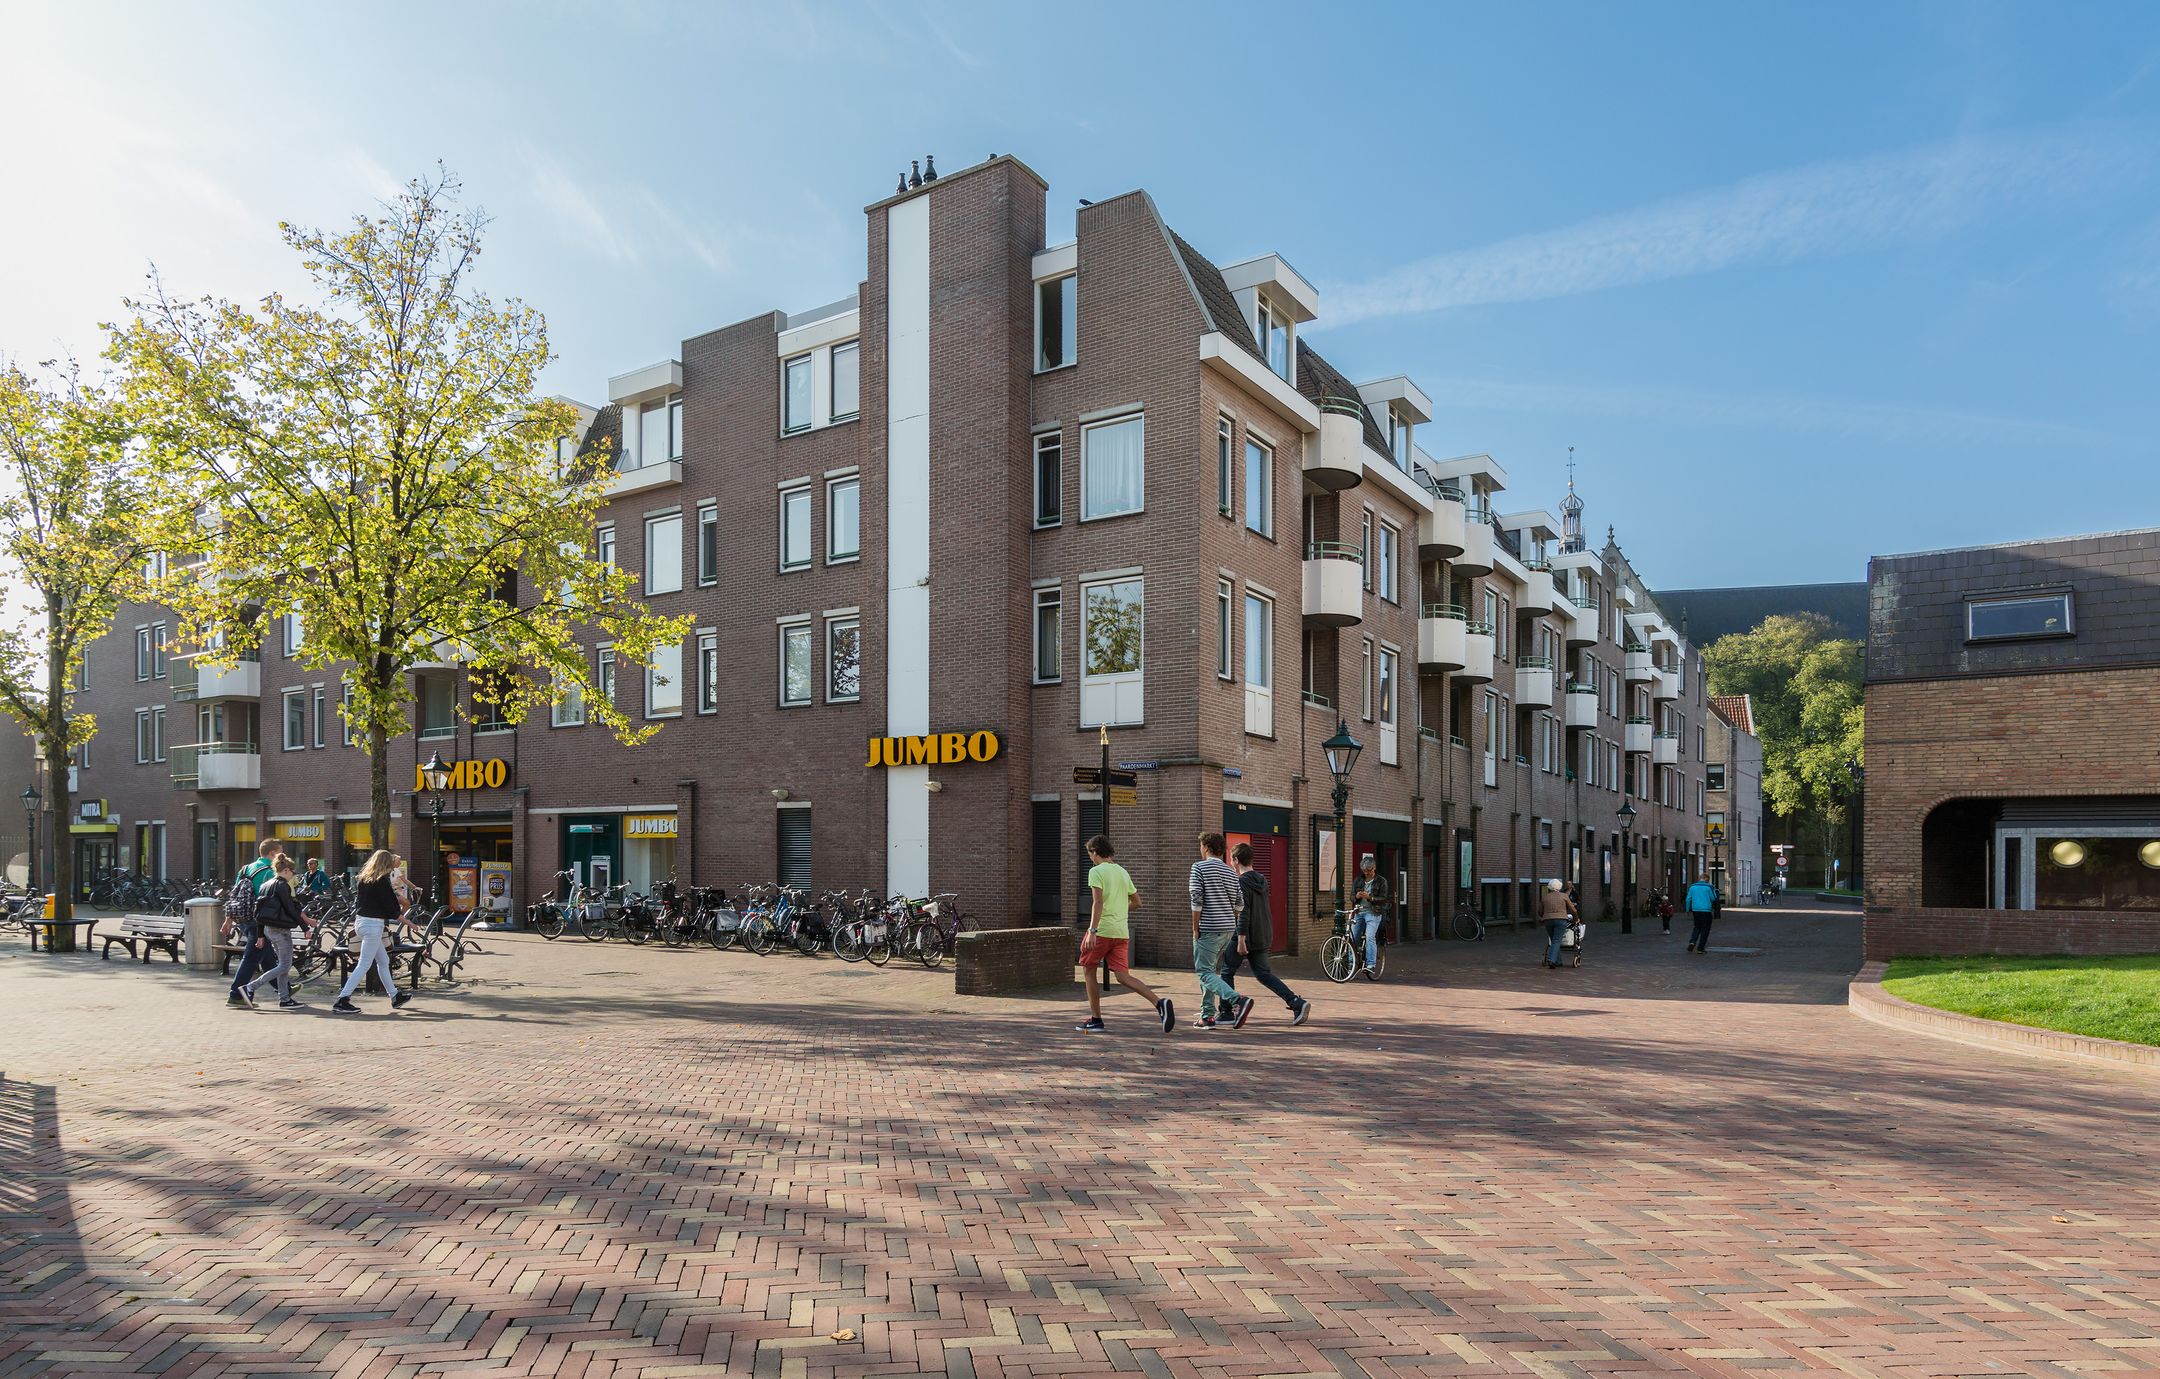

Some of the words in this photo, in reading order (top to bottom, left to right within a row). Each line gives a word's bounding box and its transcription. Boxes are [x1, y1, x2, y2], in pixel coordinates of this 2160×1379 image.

[864, 730, 999, 768] JUMBO
[412, 758, 507, 793] JMBO
[81, 803, 101, 817] MITRA
[288, 825, 320, 838] JUMBO
